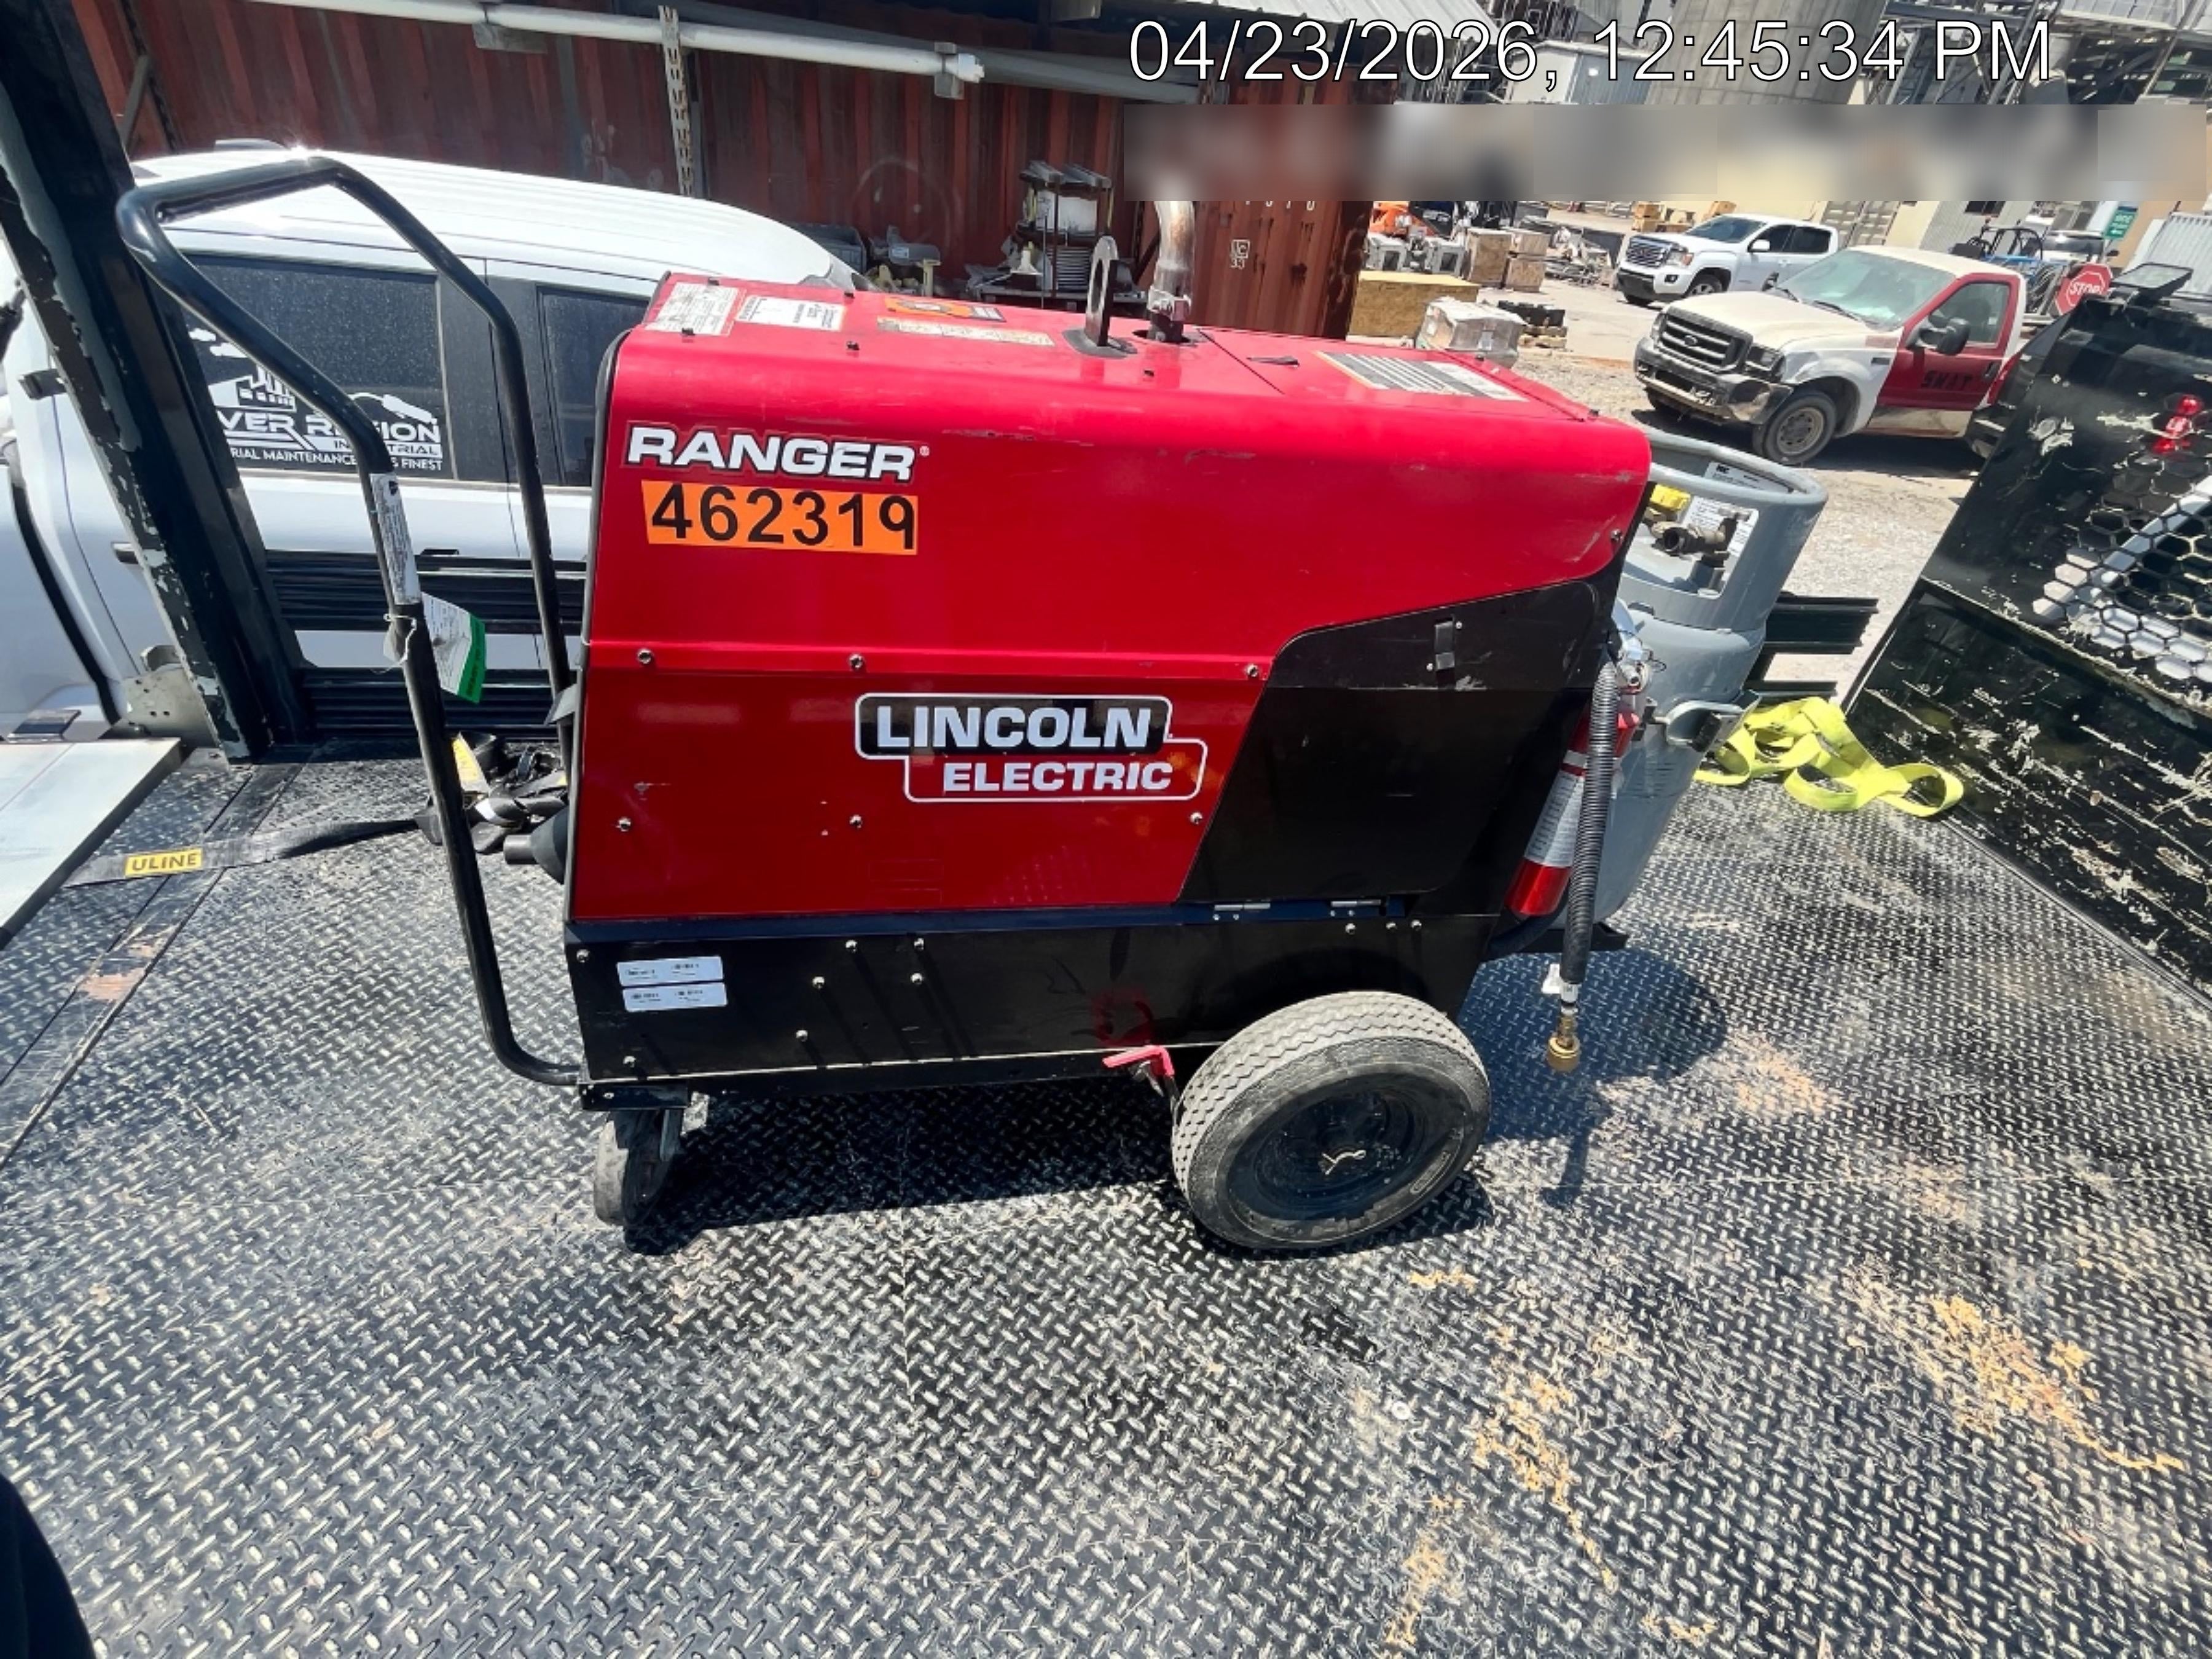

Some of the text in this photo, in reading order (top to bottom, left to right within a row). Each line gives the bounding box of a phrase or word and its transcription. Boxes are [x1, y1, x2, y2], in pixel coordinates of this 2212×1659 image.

[216, 410, 441, 443] VER RION
[230, 447, 261, 460] RIAL
[262, 449, 357, 466] MAINTENANCE
[401, 458, 442, 471] FINEST
[334, 439, 439, 456] INTRIAL
[626, 425, 916, 481] RANGER
[651, 483, 916, 551] 462319
[876, 705, 1151, 748] LINCOLN
[943, 762, 1173, 792] ELECTRIC
[131, 852, 197, 871] ULINE
